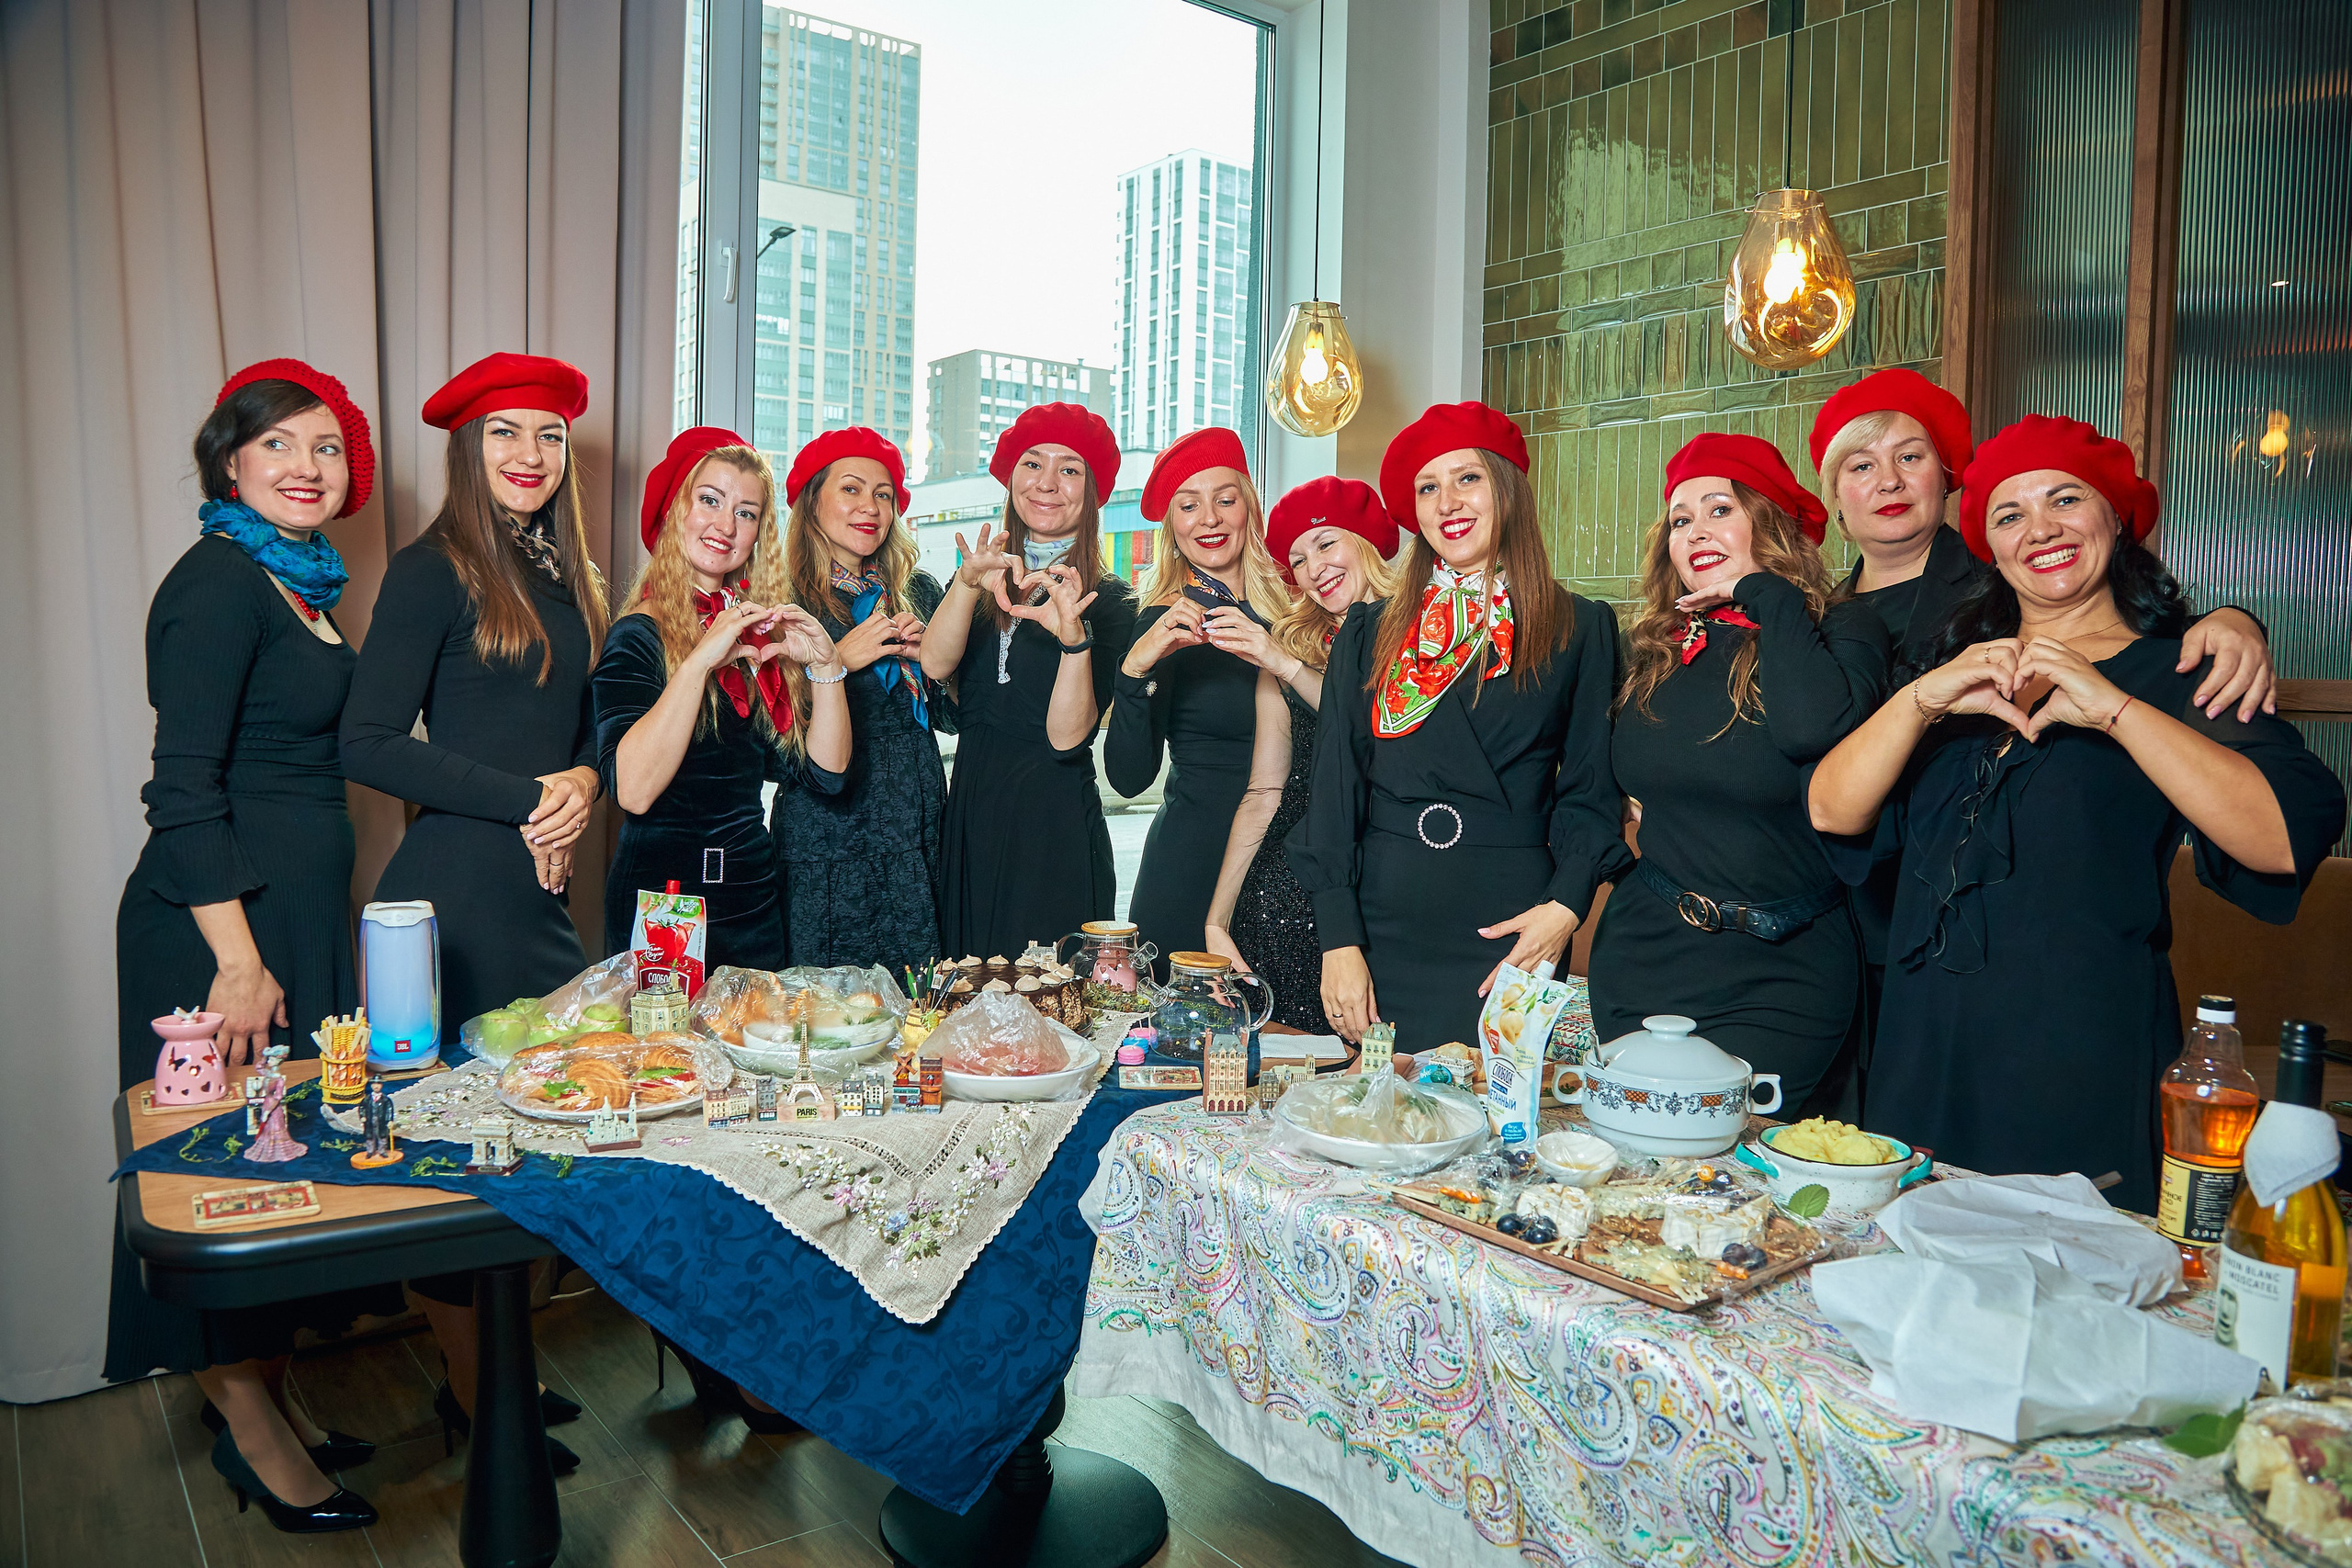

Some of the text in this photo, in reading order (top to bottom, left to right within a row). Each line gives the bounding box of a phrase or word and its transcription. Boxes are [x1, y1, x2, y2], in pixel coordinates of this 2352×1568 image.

[648, 972, 680, 984] СЛОБО
[1492, 1064, 1513, 1086] СЛОБОДА
[1487, 1089, 1516, 1111] ЕТАННЫЙ
[797, 1108, 817, 1116] PARIS
[2229, 1270, 2278, 1294] MOSCATEL
[2245, 1265, 2280, 1282] BLANC
